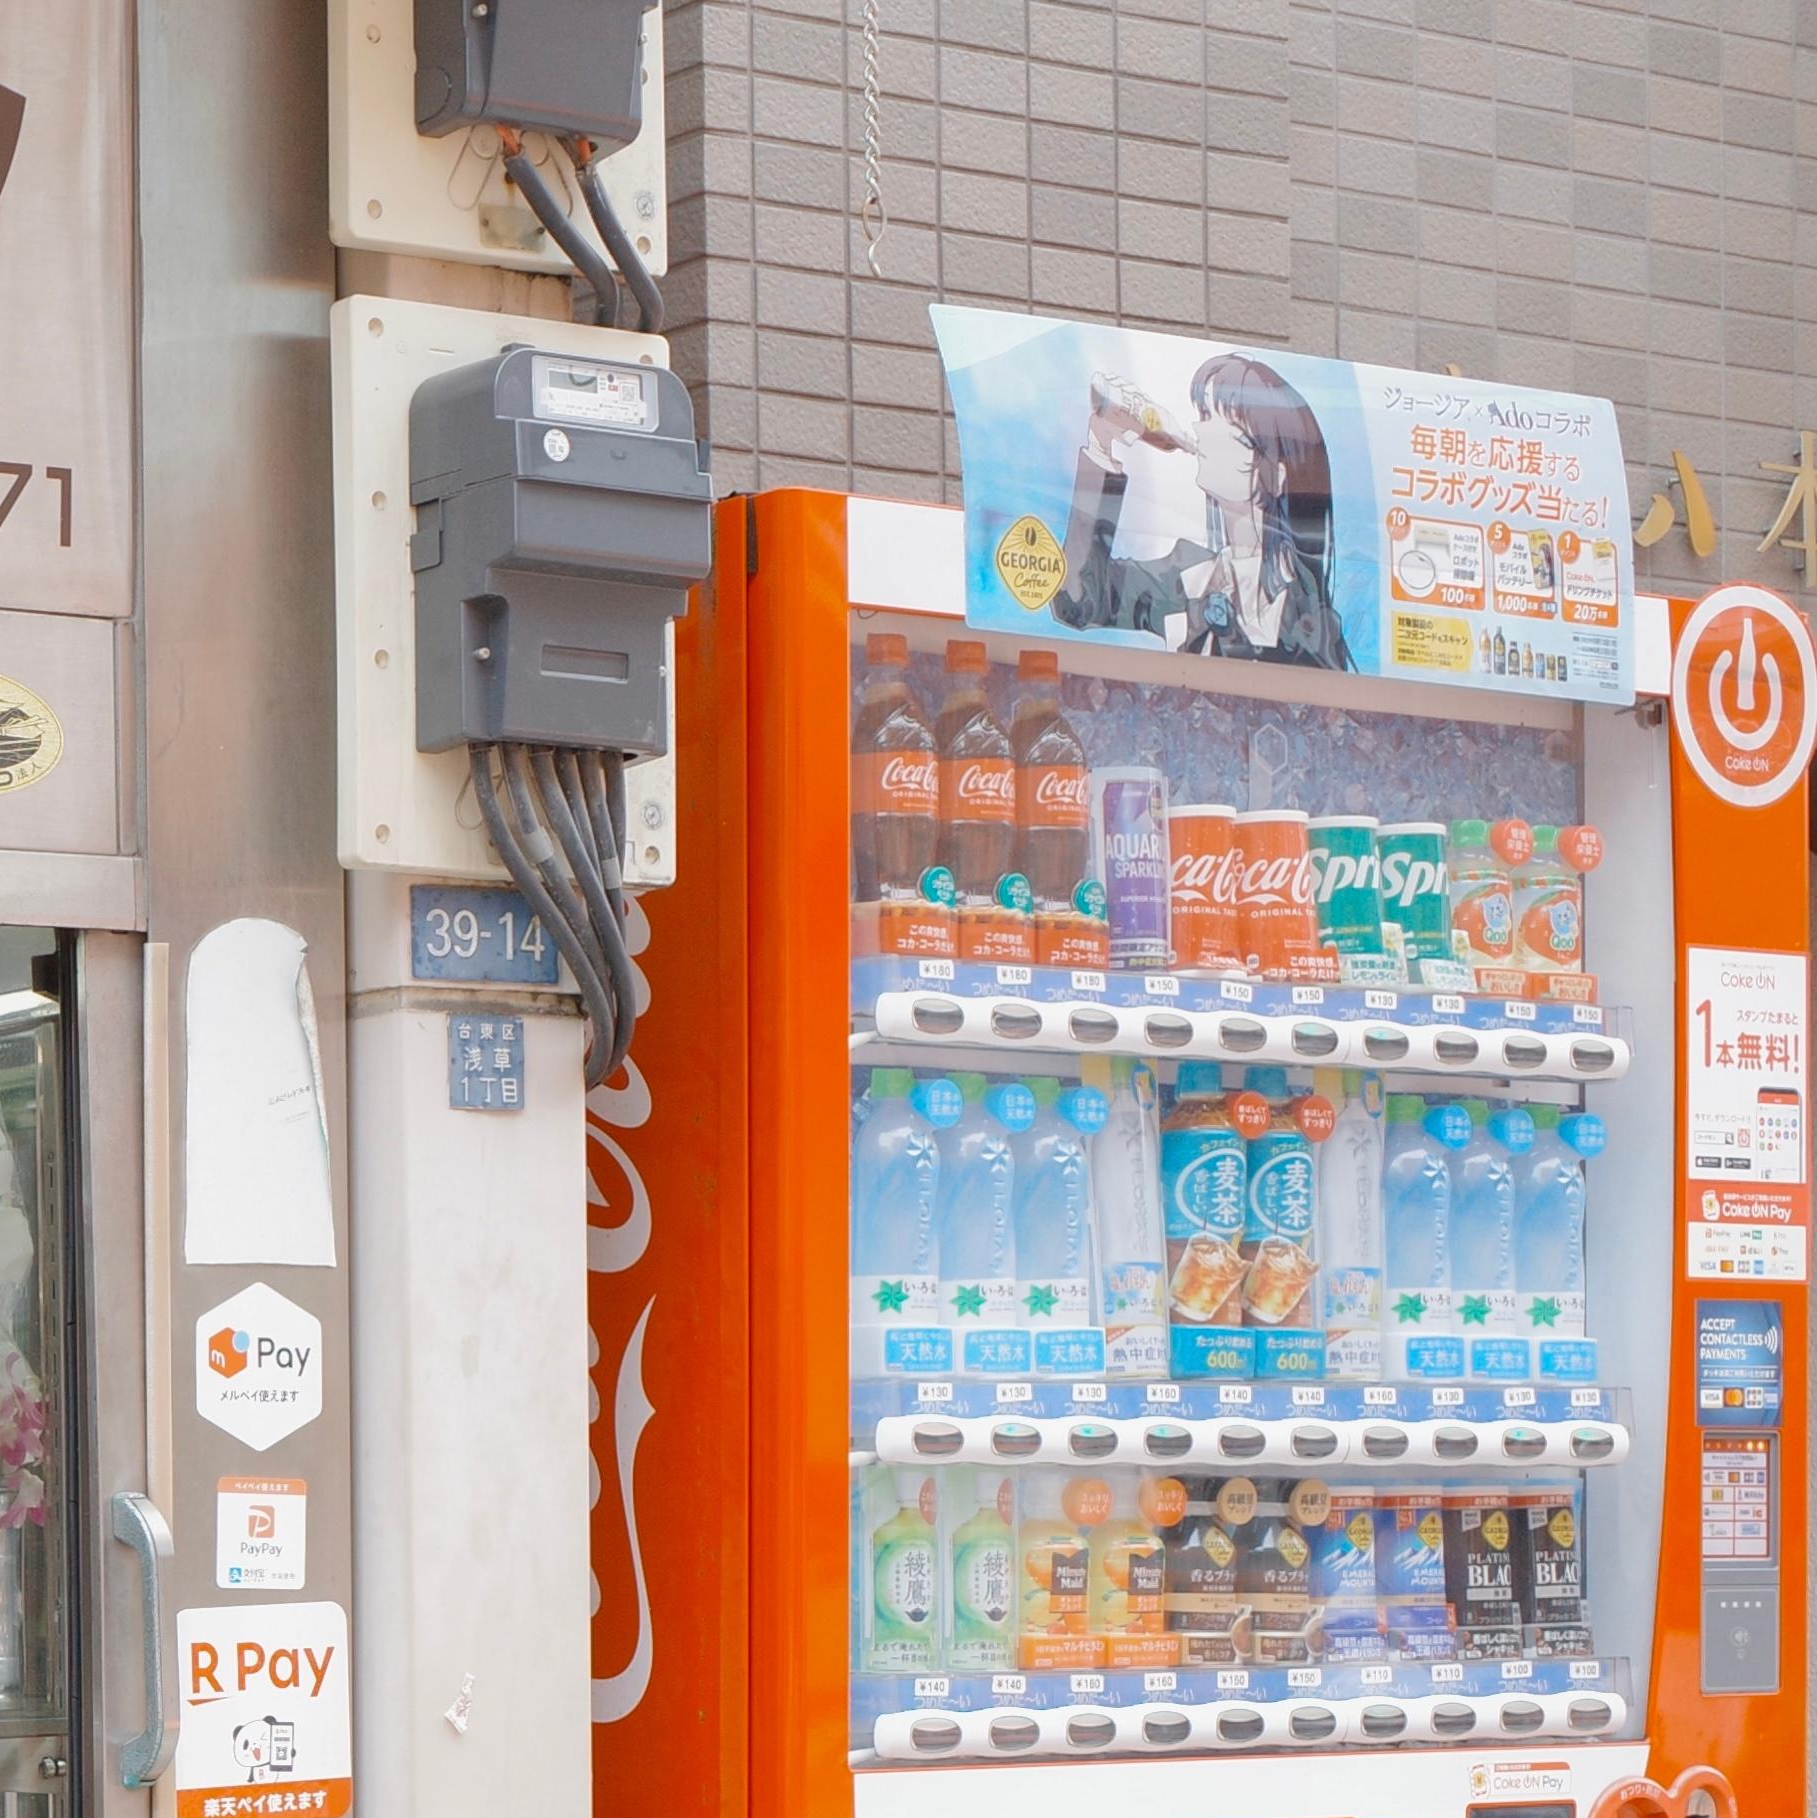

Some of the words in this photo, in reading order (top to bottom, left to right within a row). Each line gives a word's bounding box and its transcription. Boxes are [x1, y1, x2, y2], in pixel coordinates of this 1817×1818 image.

[1410, 424, 1580, 482] 毎朝を応援する
[1494, 524, 1502, 539] 5
[1001, 552, 1061, 574] GEORGIA
[1014, 572, 1049, 589] Coffee
[1173, 907, 1219, 916] ORIGINAL
[1251, 910, 1303, 919] ORIGINAL
[425, 908, 546, 962] 39-14
[1550, 932, 1575, 949] Qoo
[922, 964, 951, 977] ¥180
[1001, 968, 1027, 981] ¥180
[1721, 972, 1752, 989] Coke
[1225, 985, 1249, 999] ¥150
[1297, 989, 1320, 1001] ¥150
[1370, 995, 1393, 1007] ¥130
[1437, 998, 1459, 1010] ¥130
[1509, 1006, 1531, 1018] ¥150
[1576, 1009, 1599, 1021] ¥150
[1736, 1009, 1799, 1026] スタンプたまると
[458, 1023, 515, 1040] 台東区
[464, 1046, 512, 1072] 浅草
[461, 1077, 518, 1103] 1丁目
[1211, 1159, 1242, 1225] 麦茶
[1282, 1160, 1310, 1226] 麦茶
[1722, 1202, 1749, 1218] Coke
[1770, 1205, 1792, 1223] Pay
[1701, 1318, 1735, 1331] ACCEPT
[1700, 1332, 1764, 1346] CONTACTLESS
[257, 1337, 311, 1377] Pay
[1700, 1347, 1747, 1361] PAYMENTS
[220, 1389, 300, 1403] メルペイ使えます
[922, 1387, 948, 1398] ¥130
[1001, 1387, 1026, 1398] ¥130
[1077, 1387, 1102, 1398] ¥130
[1151, 1388, 1176, 1399] ¥160
[1224, 1389, 1248, 1400] ¥140
[1298, 1390, 1321, 1402] ¥140
[1369, 1390, 1393, 1402] ¥160
[1437, 1391, 1459, 1402] ¥130
[1509, 1391, 1531, 1403] ¥130
[1575, 1391, 1597, 1403] ¥130
[240, 1542, 283, 1558] PayPay
[904, 1551, 927, 1605] 綾鷹
[190, 1641, 225, 1694] R
[236, 1641, 335, 1698] Pay
[1366, 1670, 1388, 1681] ¥110
[1436, 1668, 1460, 1679] ¥110
[1506, 1664, 1529, 1676] ¥100
[1574, 1664, 1597, 1676] ¥100
[919, 1682, 945, 1693] ¥140
[996, 1679, 1021, 1690] ¥140
[1075, 1678, 1100, 1689] ¥160
[1149, 1676, 1173, 1687] ¥160
[1494, 1777, 1520, 1790] Coke
[1543, 1775, 1564, 1790] Pay
[204, 1790, 328, 1818] 楽天ペイ使えます
